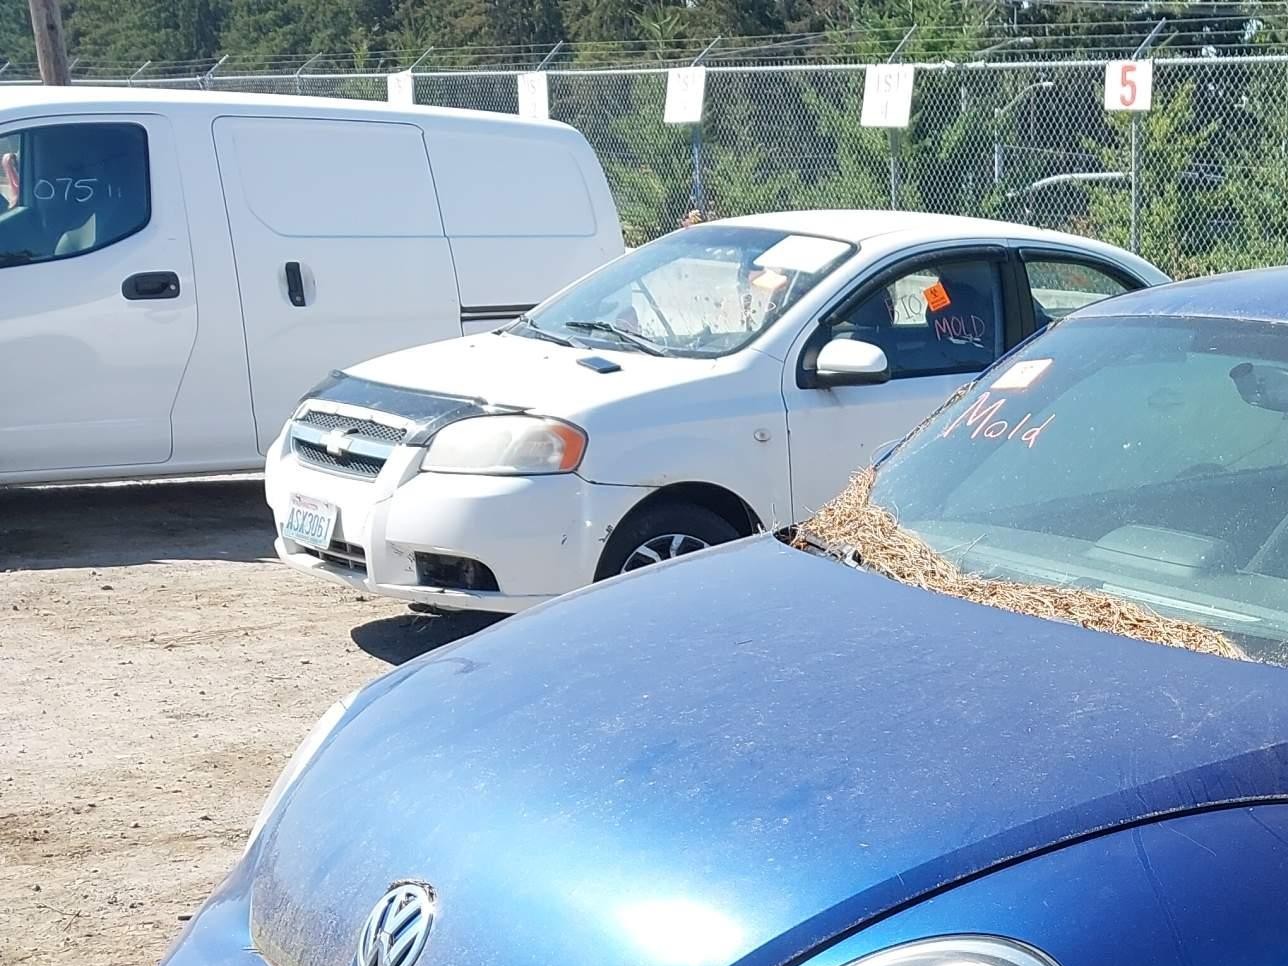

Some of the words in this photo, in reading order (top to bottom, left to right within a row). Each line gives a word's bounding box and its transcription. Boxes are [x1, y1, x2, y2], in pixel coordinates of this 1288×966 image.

[1120, 64, 1137, 107] 5
[935, 314, 985, 341] MOLD
[942, 391, 1056, 448] Mold
